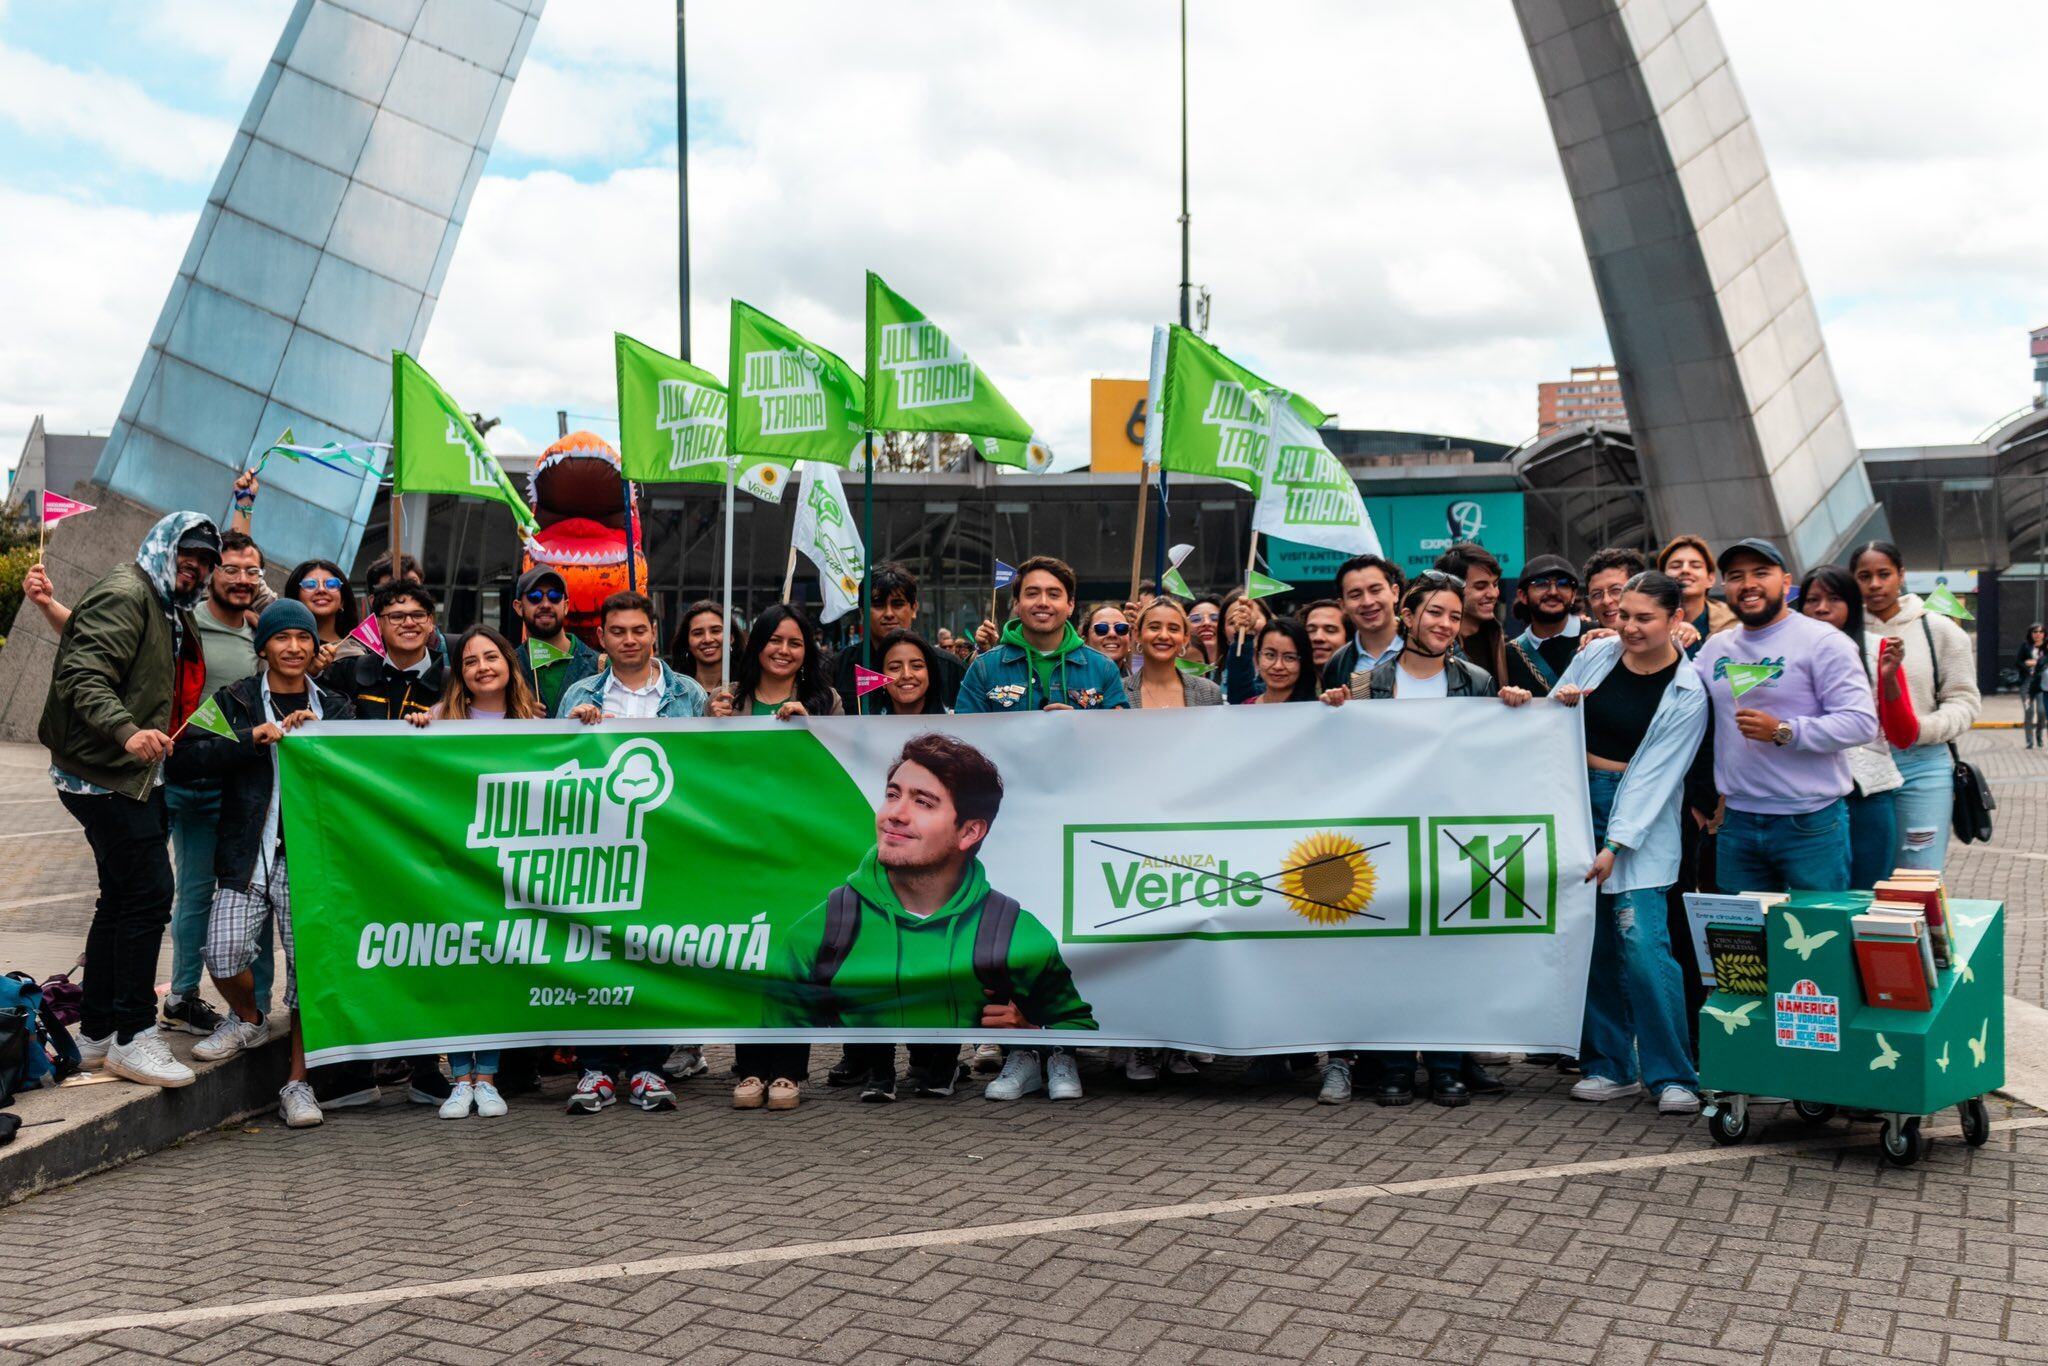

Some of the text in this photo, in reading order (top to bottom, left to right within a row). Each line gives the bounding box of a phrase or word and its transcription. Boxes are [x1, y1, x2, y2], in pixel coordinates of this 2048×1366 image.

[901, 362, 971, 404] TRIANA
[764, 393, 823, 431] TRIANA
[1126, 399, 1147, 446] 6
[675, 425, 727, 465] TRIAN
[748, 481, 779, 501] Verde
[1289, 488, 1359, 522] TRIANA
[477, 771, 604, 840] JULIÁN
[508, 845, 640, 906] TRIANA
[1141, 854, 1216, 869] ALIANZA
[1459, 835, 1525, 919] 11
[1101, 860, 1264, 909] Verde
[357, 912, 772, 971] CONCEJAL DE BOGOTÁ
[529, 986, 635, 1006] 2024-2027
